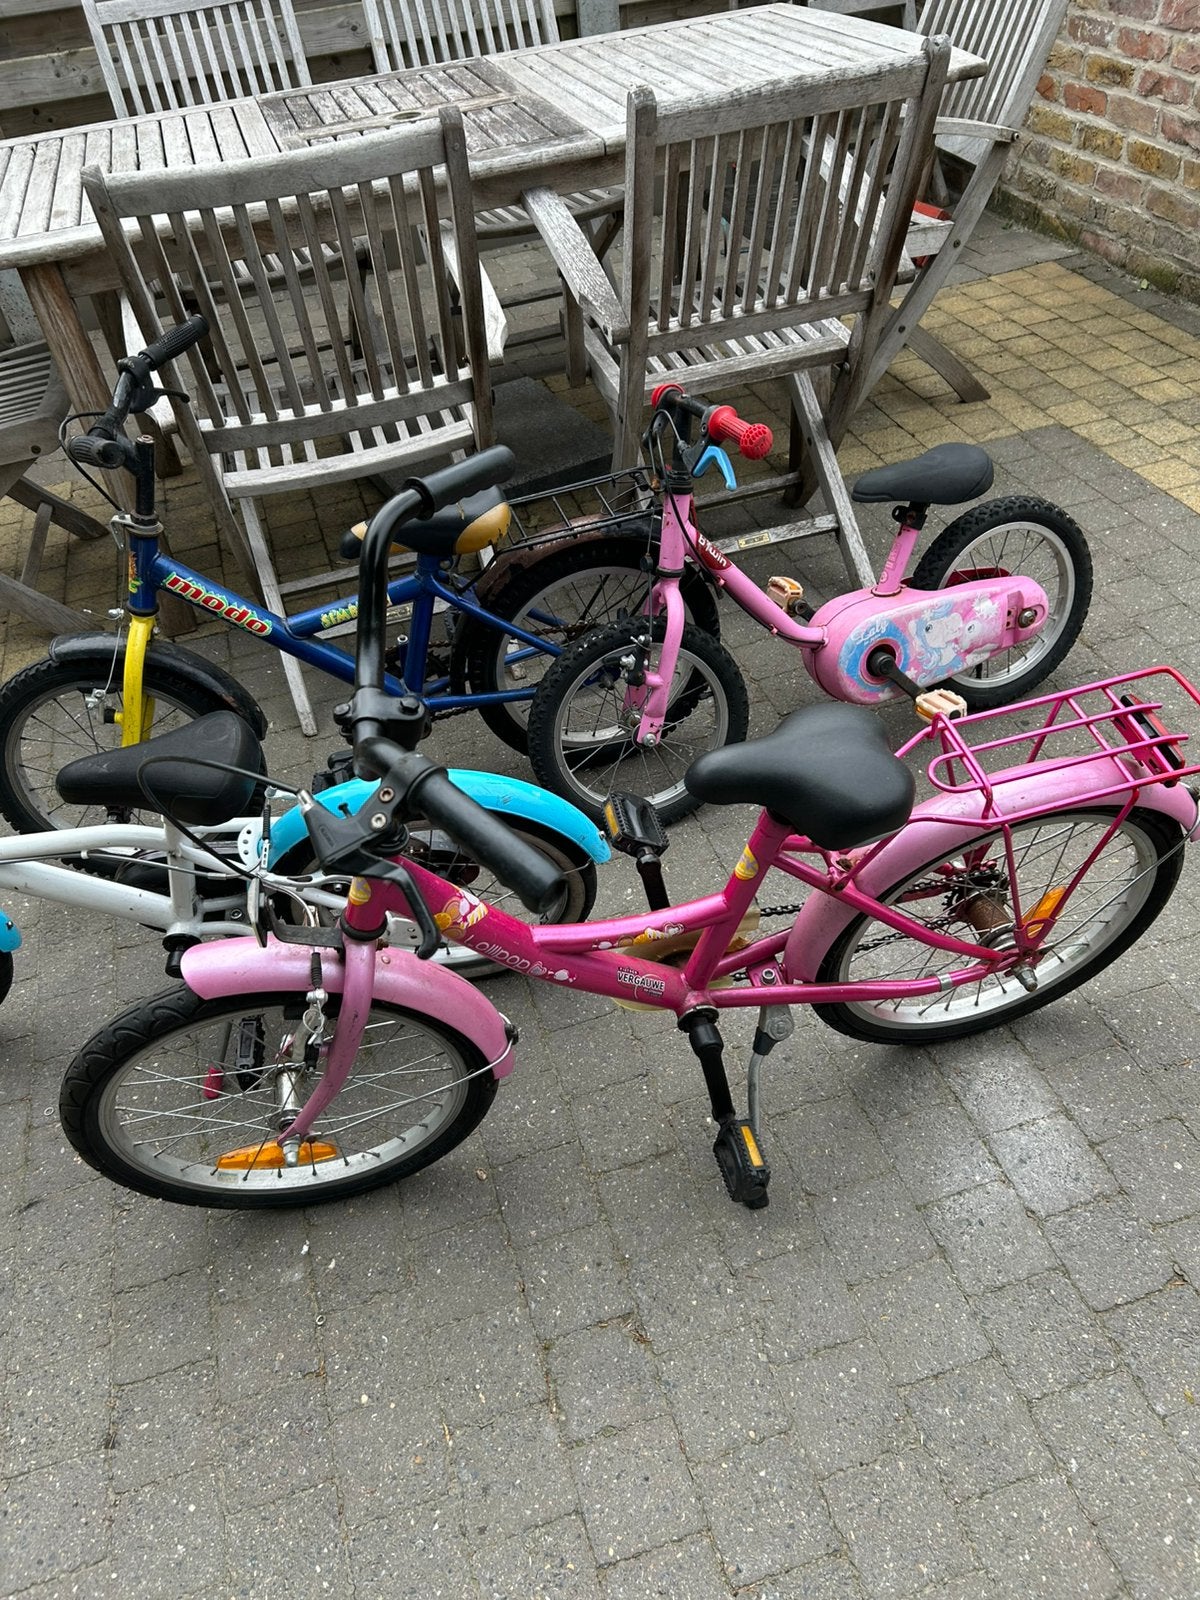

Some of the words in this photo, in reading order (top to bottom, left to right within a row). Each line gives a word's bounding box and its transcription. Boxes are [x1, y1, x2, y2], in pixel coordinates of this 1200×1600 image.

[165, 574, 271, 635] modo
[320, 601, 358, 629] SIMB
[617, 970, 666, 992] VERGAUWE
